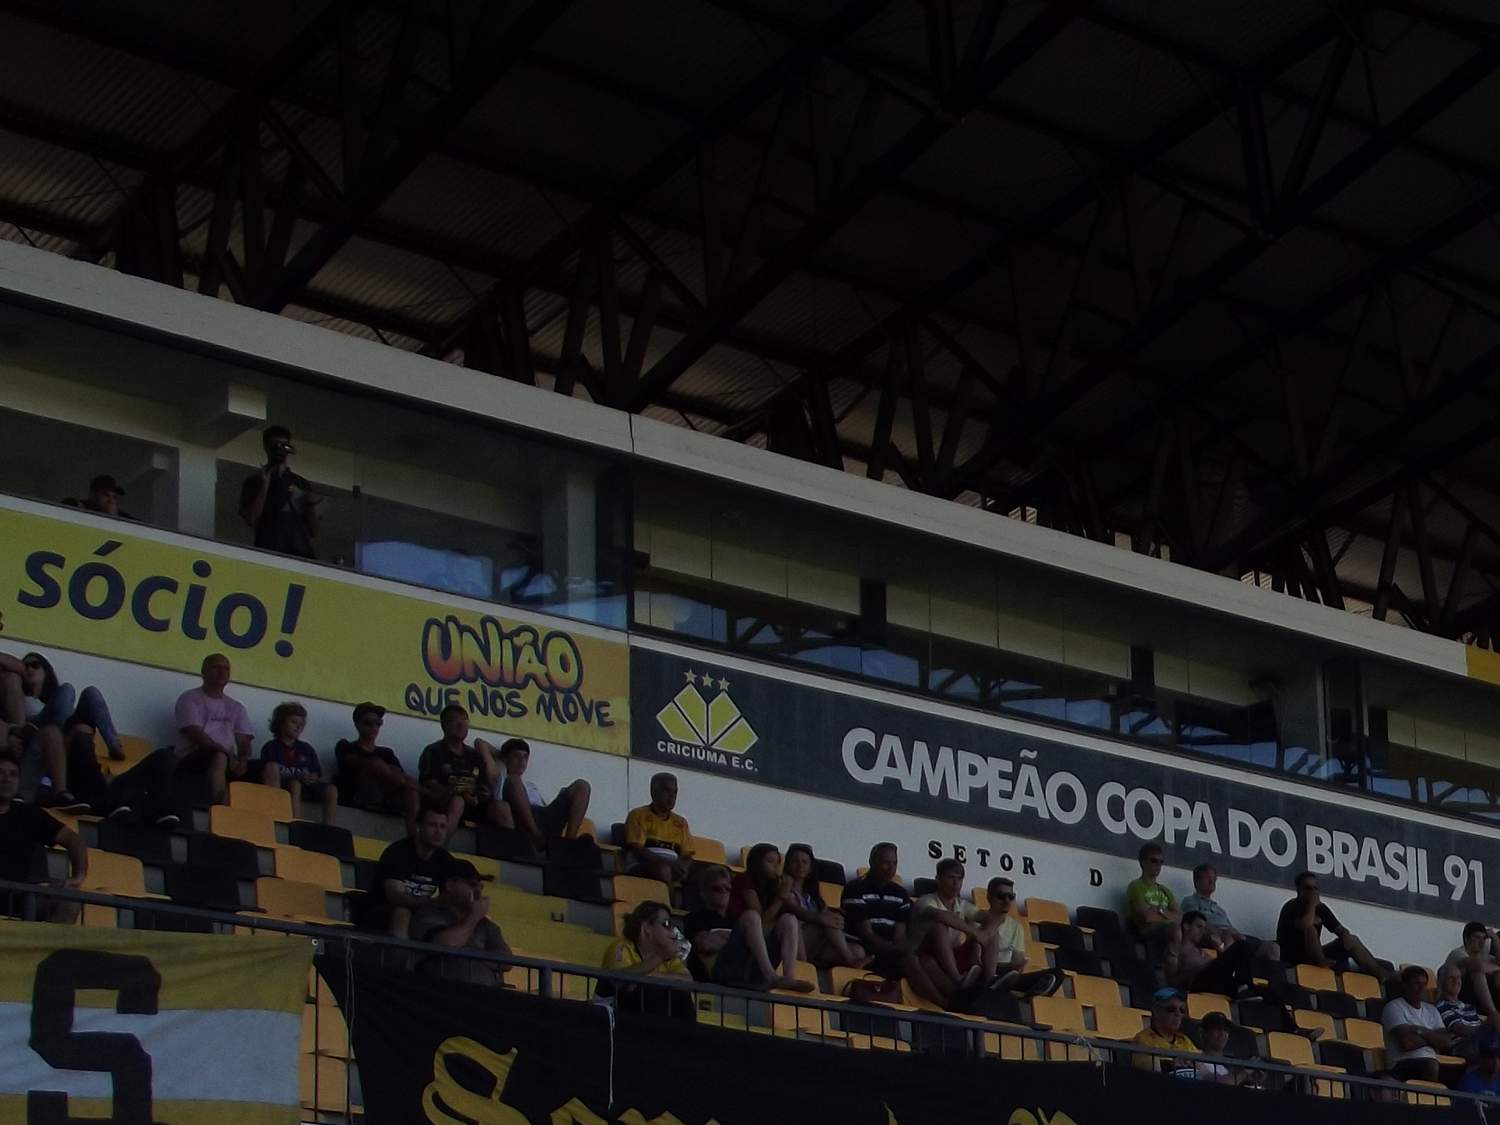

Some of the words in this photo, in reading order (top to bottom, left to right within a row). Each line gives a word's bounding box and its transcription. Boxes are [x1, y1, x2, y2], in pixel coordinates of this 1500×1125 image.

[18, 540, 306, 657] sócio!
[422, 615, 583, 693] UNIÃO
[468, 684, 528, 718] NOS
[536, 692, 615, 727] MOVE
[841, 727, 1087, 825] CAMPEÃO
[1097, 780, 1223, 853] COPA
[1228, 809, 1298, 868] DO
[1305, 824, 1439, 899] BRASIL
[1444, 857, 1486, 906] 91
[928, 839, 1036, 876] SETOR
[1089, 869, 1103, 888] D
